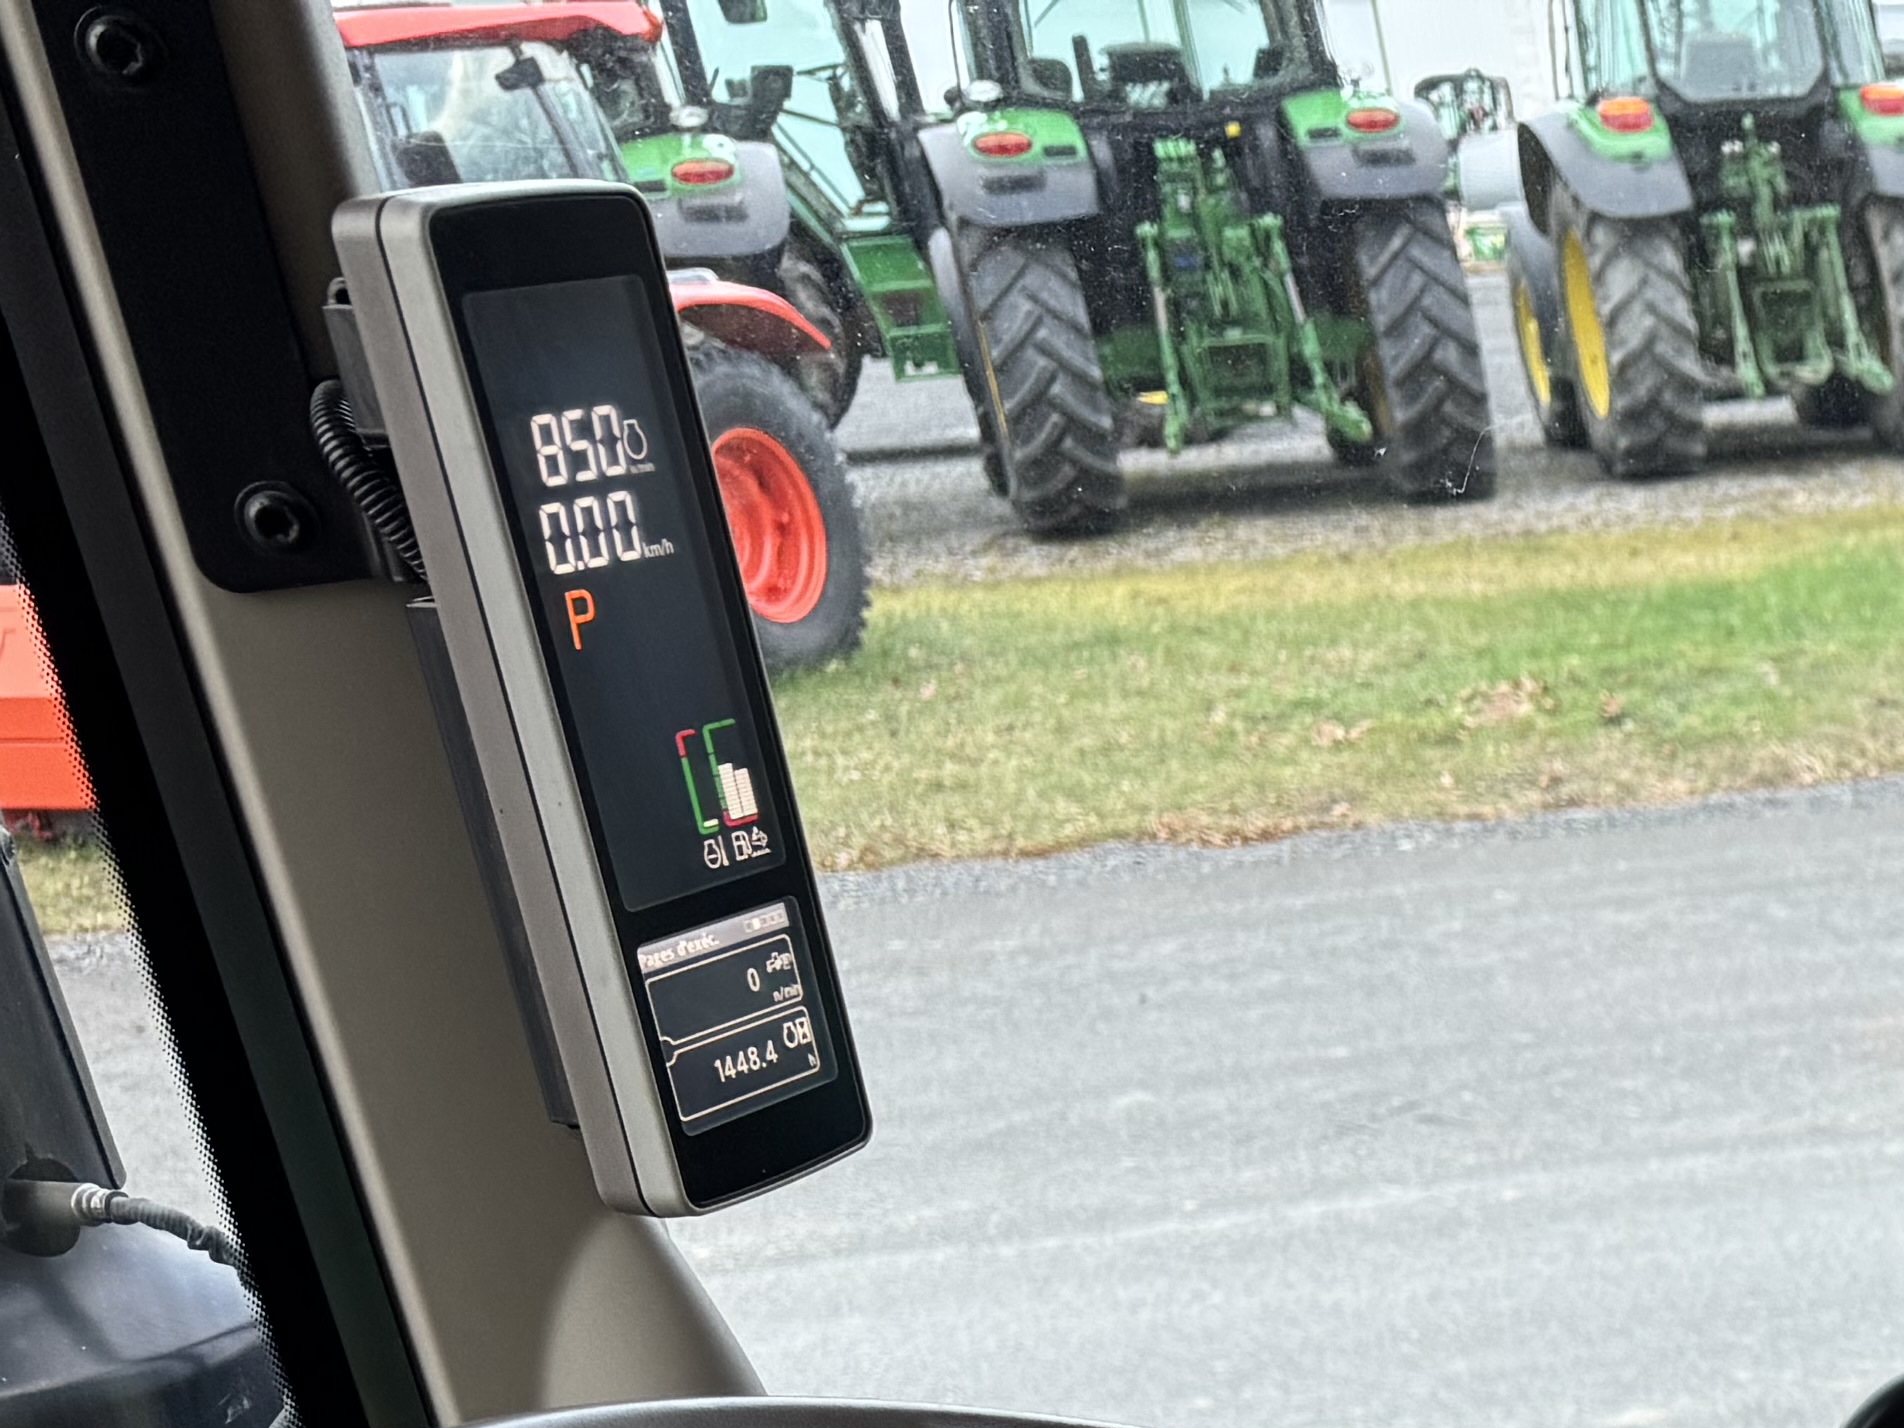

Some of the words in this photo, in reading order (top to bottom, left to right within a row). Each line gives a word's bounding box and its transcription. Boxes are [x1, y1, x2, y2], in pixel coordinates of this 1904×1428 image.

[530, 404, 627, 487] 850
[538, 490, 642, 575] 0.00
[642, 538, 675, 559] km/h
[564, 588, 596, 651] P
[637, 946, 676, 970] Pages
[746, 967, 761, 992] 0
[713, 1039, 779, 1083] 1448.4
